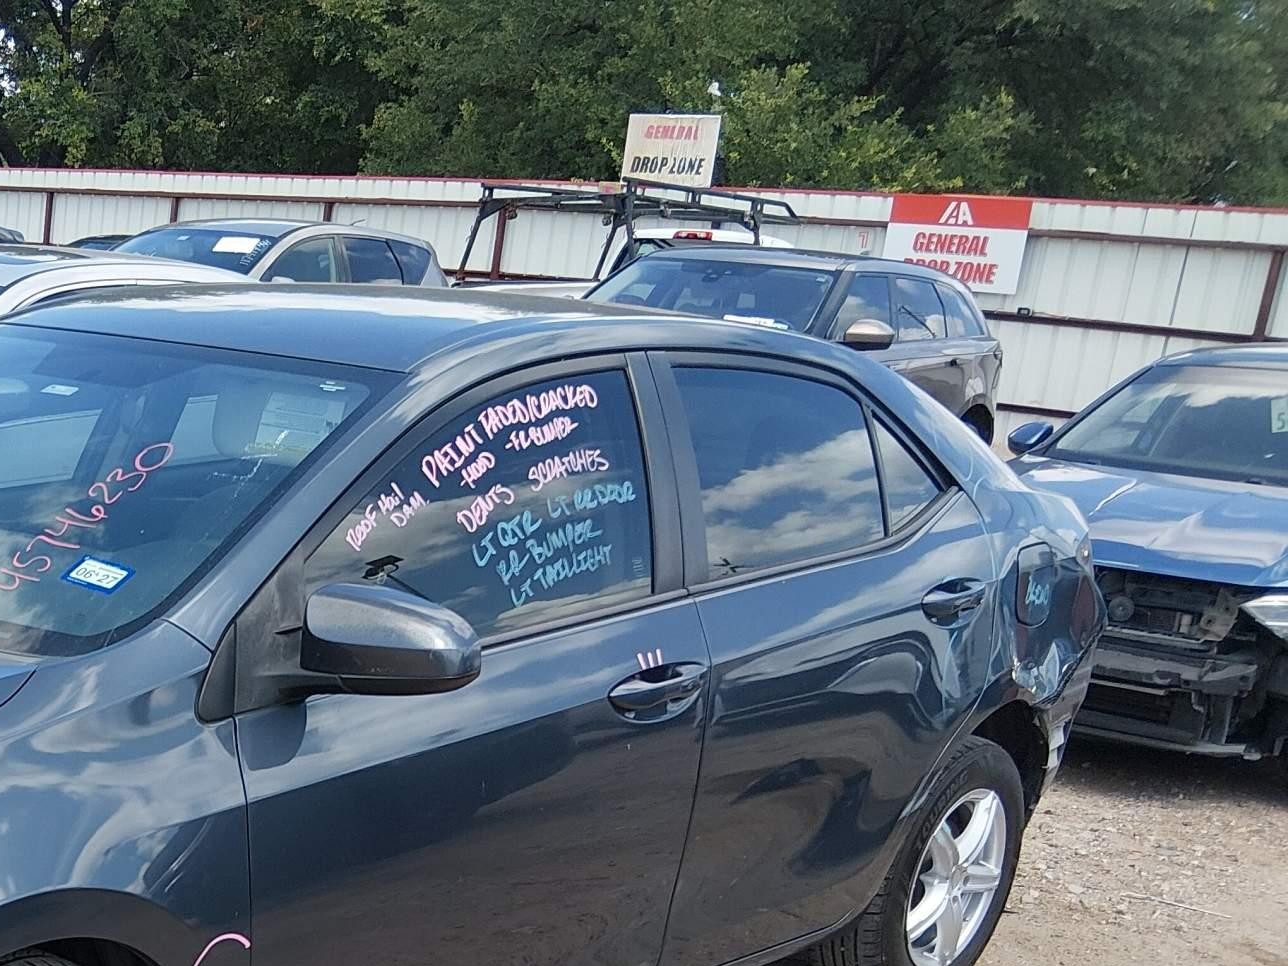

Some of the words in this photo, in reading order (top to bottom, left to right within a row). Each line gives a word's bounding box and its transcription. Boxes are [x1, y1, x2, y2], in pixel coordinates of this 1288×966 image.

[644, 125, 699, 140] GENERAL
[630, 156, 668, 174] DROP
[668, 157, 706, 176] ZONE
[913, 232, 990, 257] GENERAL
[953, 261, 998, 284] ZONE
[422, 423, 483, 488] PAINT
[456, 483, 515, 533] DENTS
[528, 449, 610, 491] SCRATCHES
[472, 532, 497, 567] LT
[497, 510, 543, 547] QTR
[526, 518, 604, 564] BUMPER
[75, 567, 92, 579] 06
[96, 574, 120, 585] 27
